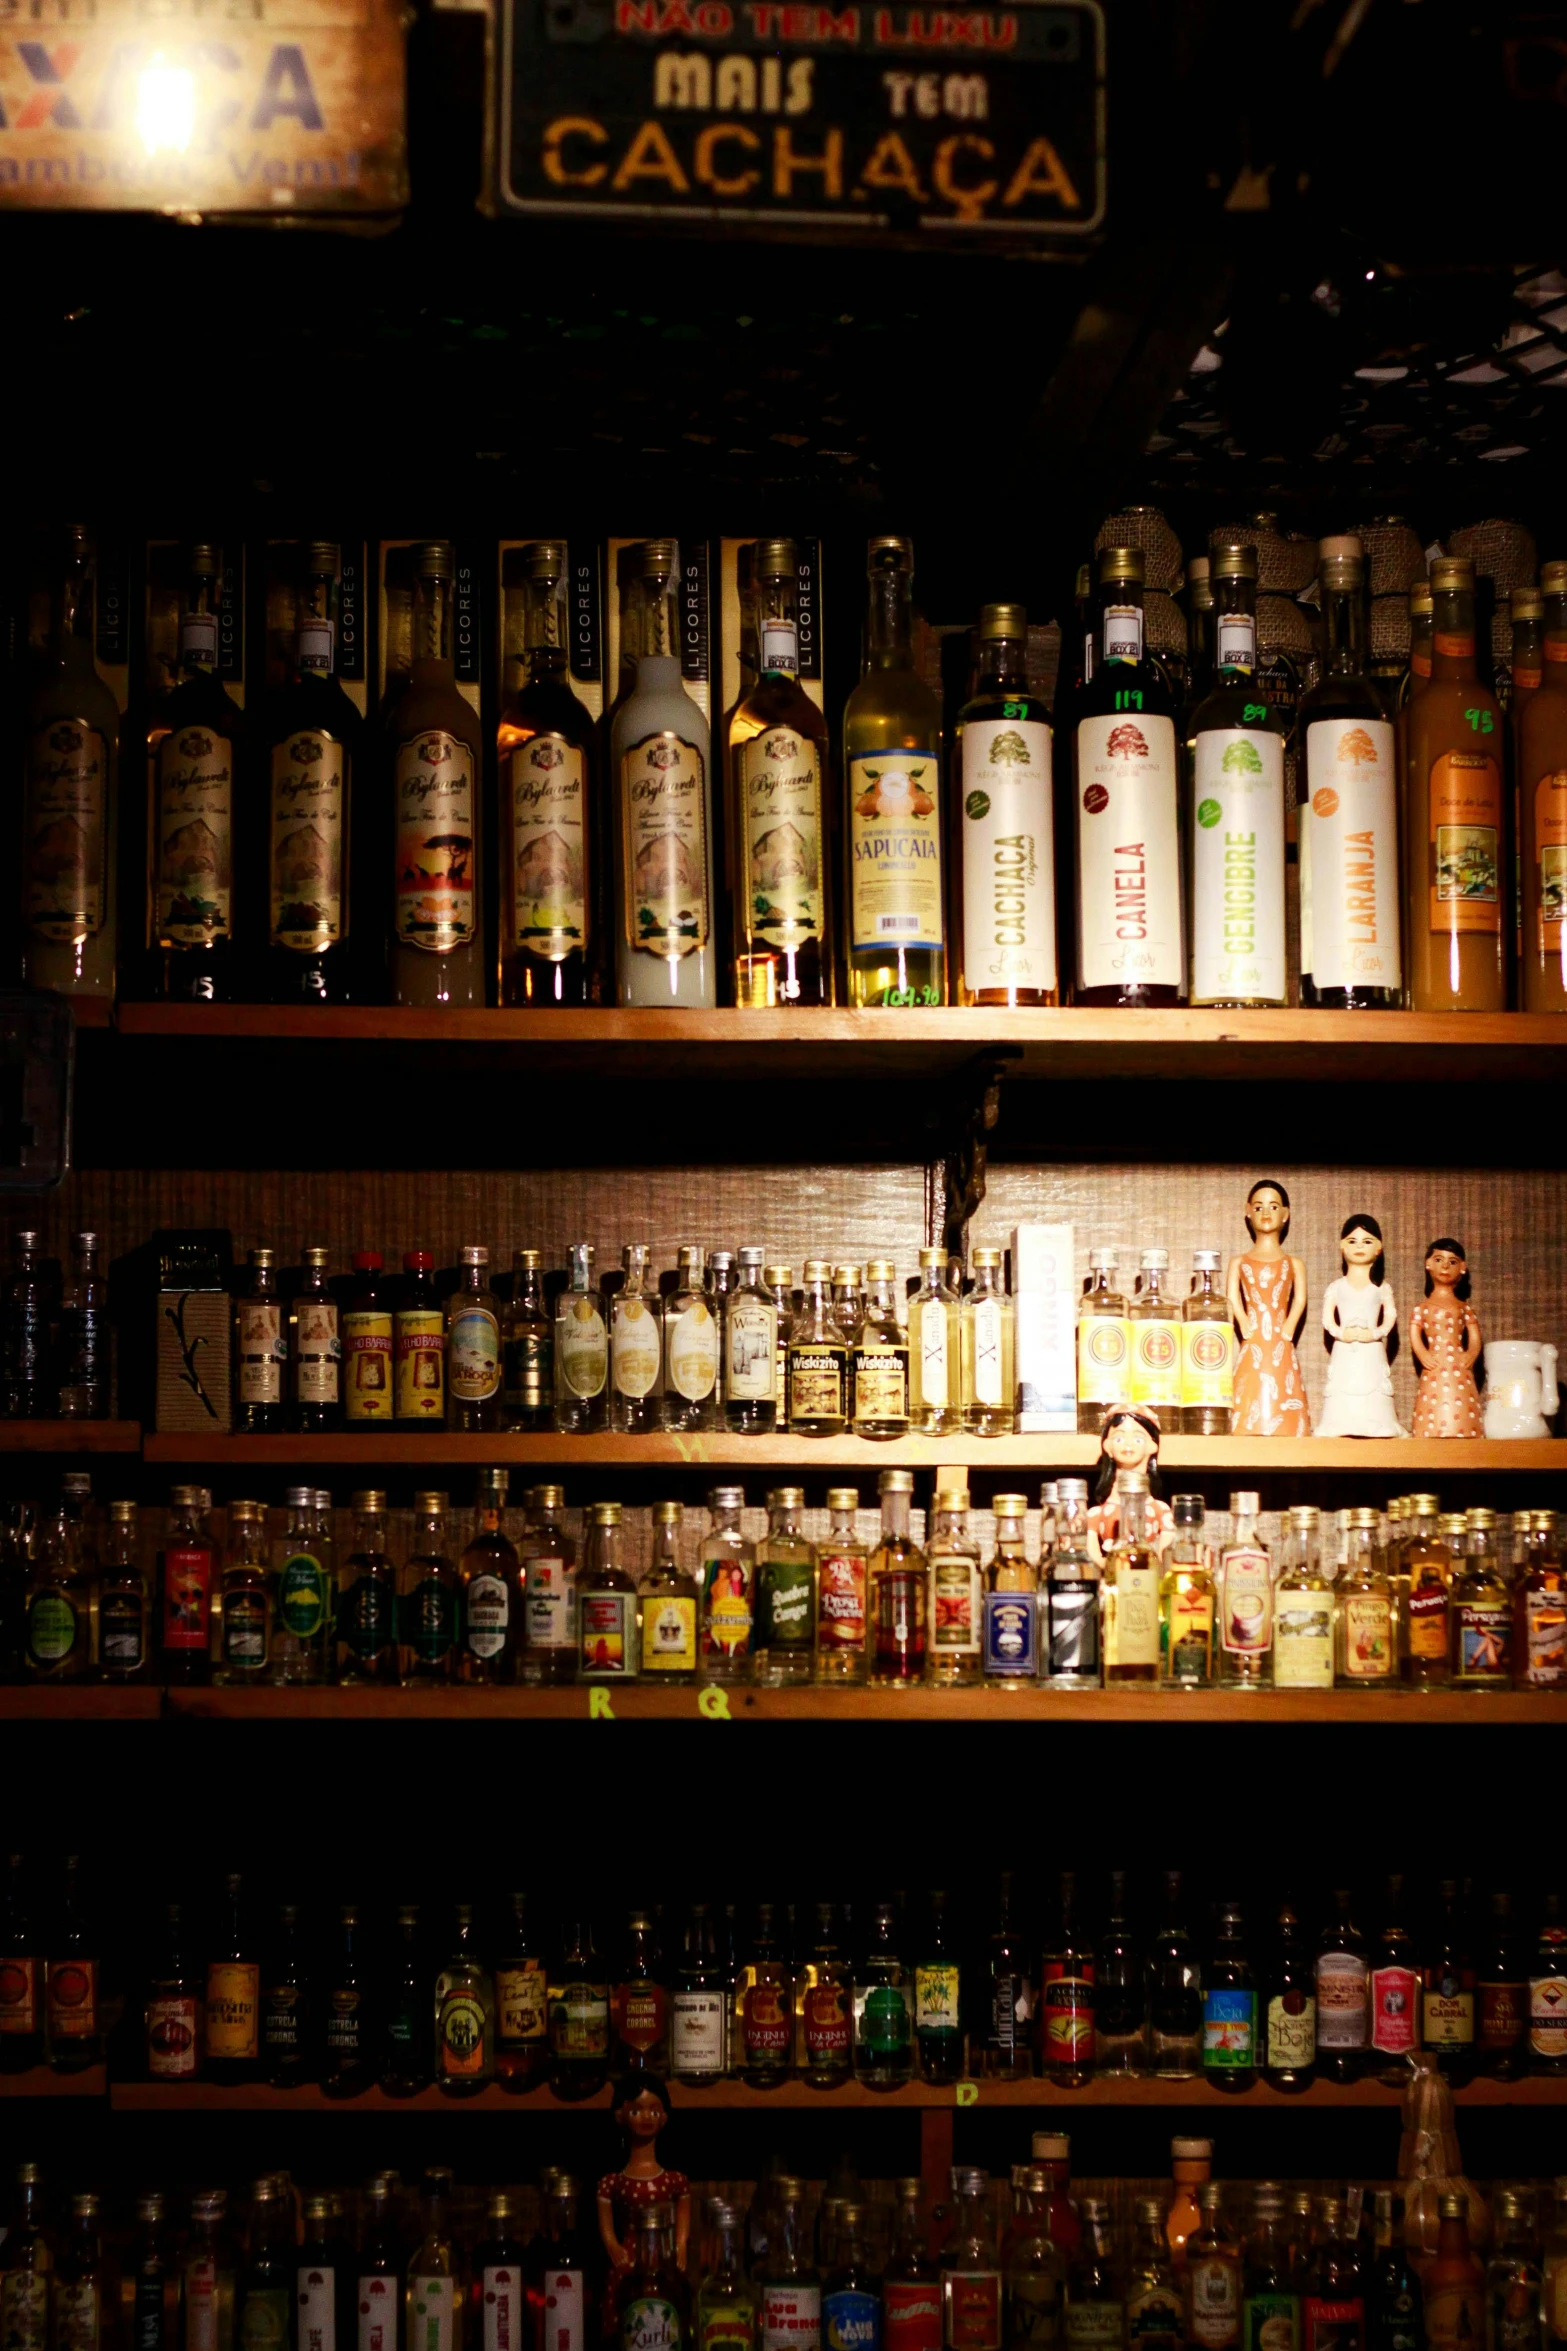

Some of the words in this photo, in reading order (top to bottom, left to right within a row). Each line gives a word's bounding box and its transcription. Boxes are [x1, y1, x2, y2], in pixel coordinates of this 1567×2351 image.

[752, 3, 858, 43] TEM
[876, 8, 1018, 48] LUXU
[653, 53, 814, 113] MAIS
[884, 71, 989, 119] TEM
[541, 116, 1081, 222] CACHAÇA
[221, 567, 234, 668] LICORES
[343, 565, 355, 668] LICORES
[459, 567, 472, 669] LICORES
[578, 565, 591, 668] LICORES
[687, 565, 699, 668] LICORES
[799, 564, 812, 667] LICORES
[1110, 646, 1127, 655] BOX
[1225, 654, 1242, 663] BOX
[768, 659, 786, 669] BOX
[1114, 689, 1144, 711] 119
[1242, 703, 1268, 722] 89
[1464, 708, 1495, 734] 95
[855, 838, 937, 862] SAPUCAIA
[1025, 834, 1036, 887] Original
[993, 834, 1026, 946] CACHAÇA
[1114, 842, 1147, 941] CANELA
[1223, 831, 1256, 955] GENGIBRE
[1343, 830, 1378, 944] LARANJA
[1150, 1343, 1169, 1355] 25
[1200, 1345, 1219, 1358] 25
[792, 1356, 840, 1370] Wiskizito
[856, 1356, 904, 1370] Wiskizito
[1352, 1612, 1389, 1625] Verde
[589, 1686, 616, 1721] R
[698, 1686, 732, 1721] Q
[1430, 2007, 1469, 2019] CABRAL
[1438, 1999, 1460, 2010] DON
[266, 2016, 297, 2028] ESTRELA
[327, 2018, 359, 2031] ESTRELA
[626, 2016, 656, 2029] CORONEL
[265, 2032, 297, 2045] CORONEL
[327, 2034, 359, 2047] CORONEL
[957, 2082, 979, 2107] D
[765, 2302, 797, 2315] Lua
